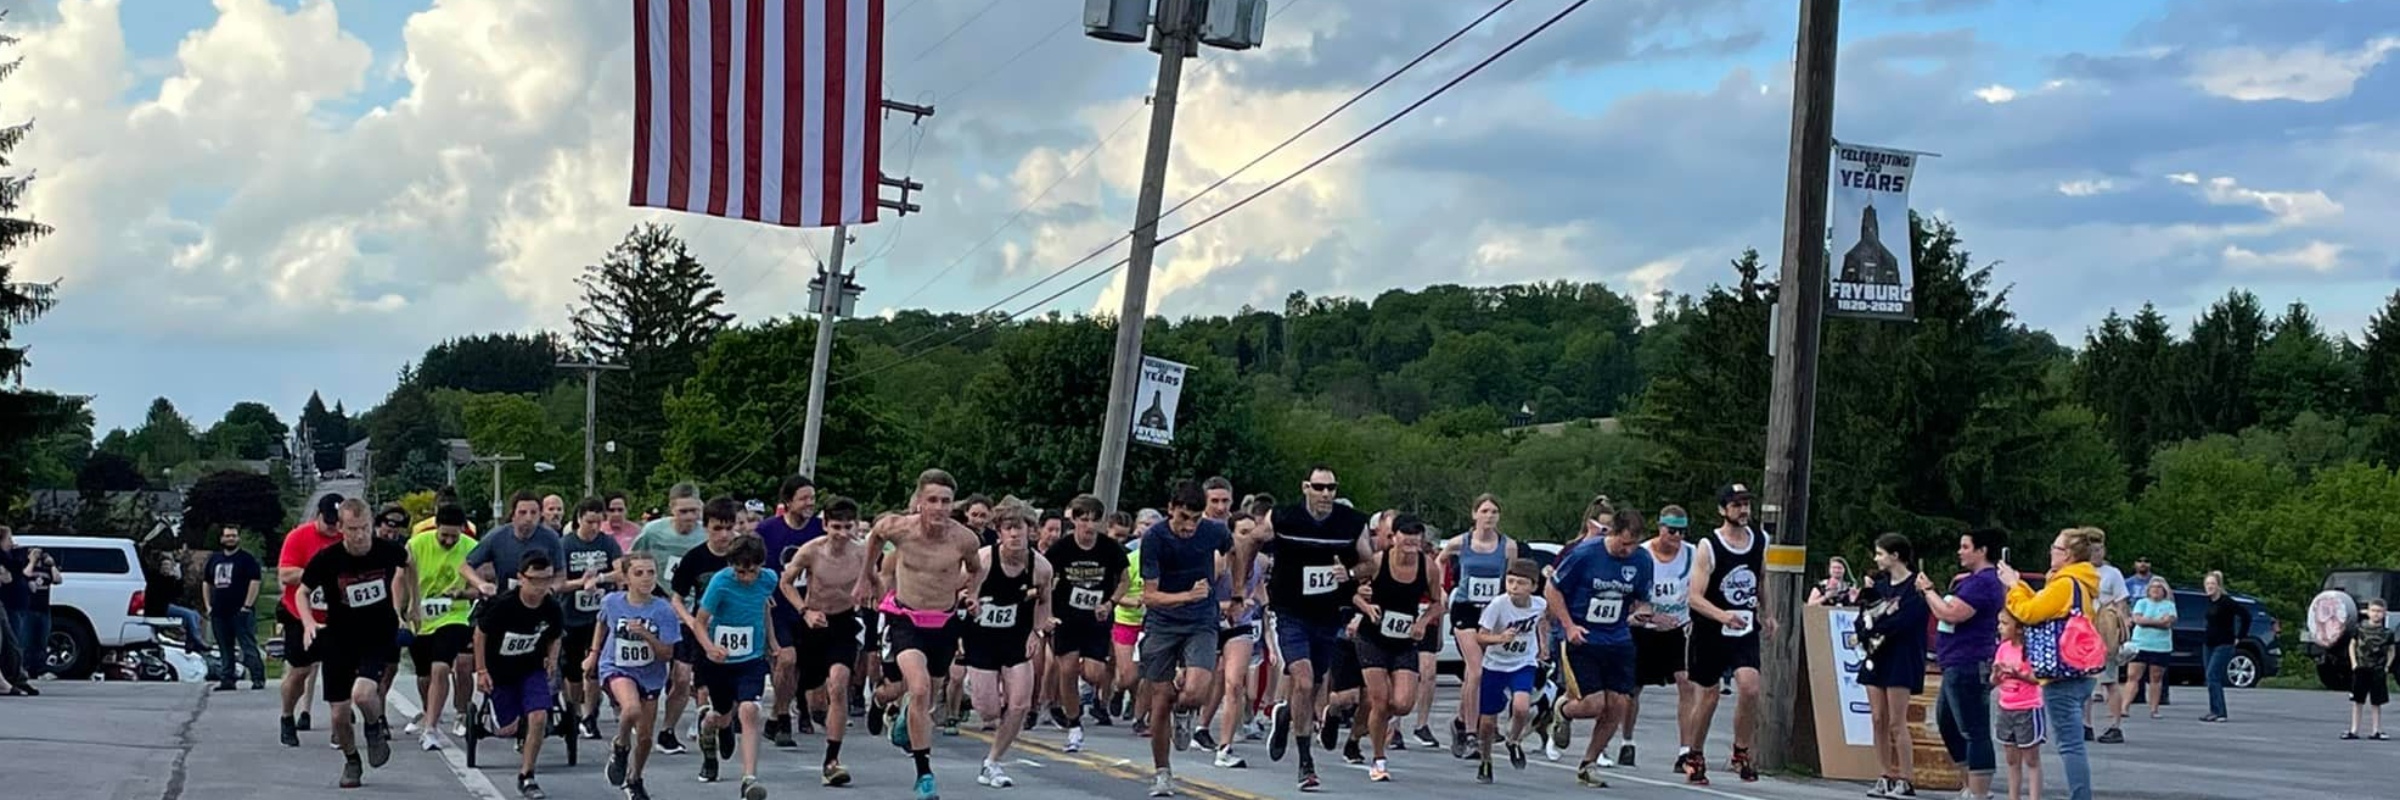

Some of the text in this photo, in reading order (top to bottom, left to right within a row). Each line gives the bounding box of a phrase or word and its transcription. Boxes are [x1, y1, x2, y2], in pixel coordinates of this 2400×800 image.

[1840, 169, 1905, 193] YEARS
[1829, 282, 1913, 302] FRYBURG
[1837, 299, 1904, 313] 1820-2020
[1145, 370, 1180, 386] YEARS
[1309, 572, 1335, 588] 612
[353, 585, 381, 602] 613
[1473, 583, 1495, 597] 611
[1655, 583, 1675, 597] 641
[987, 609, 1012, 624] 462
[1386, 619, 1412, 634] 487
[508, 637, 536, 651] 607
[720, 633, 748, 650] 484
